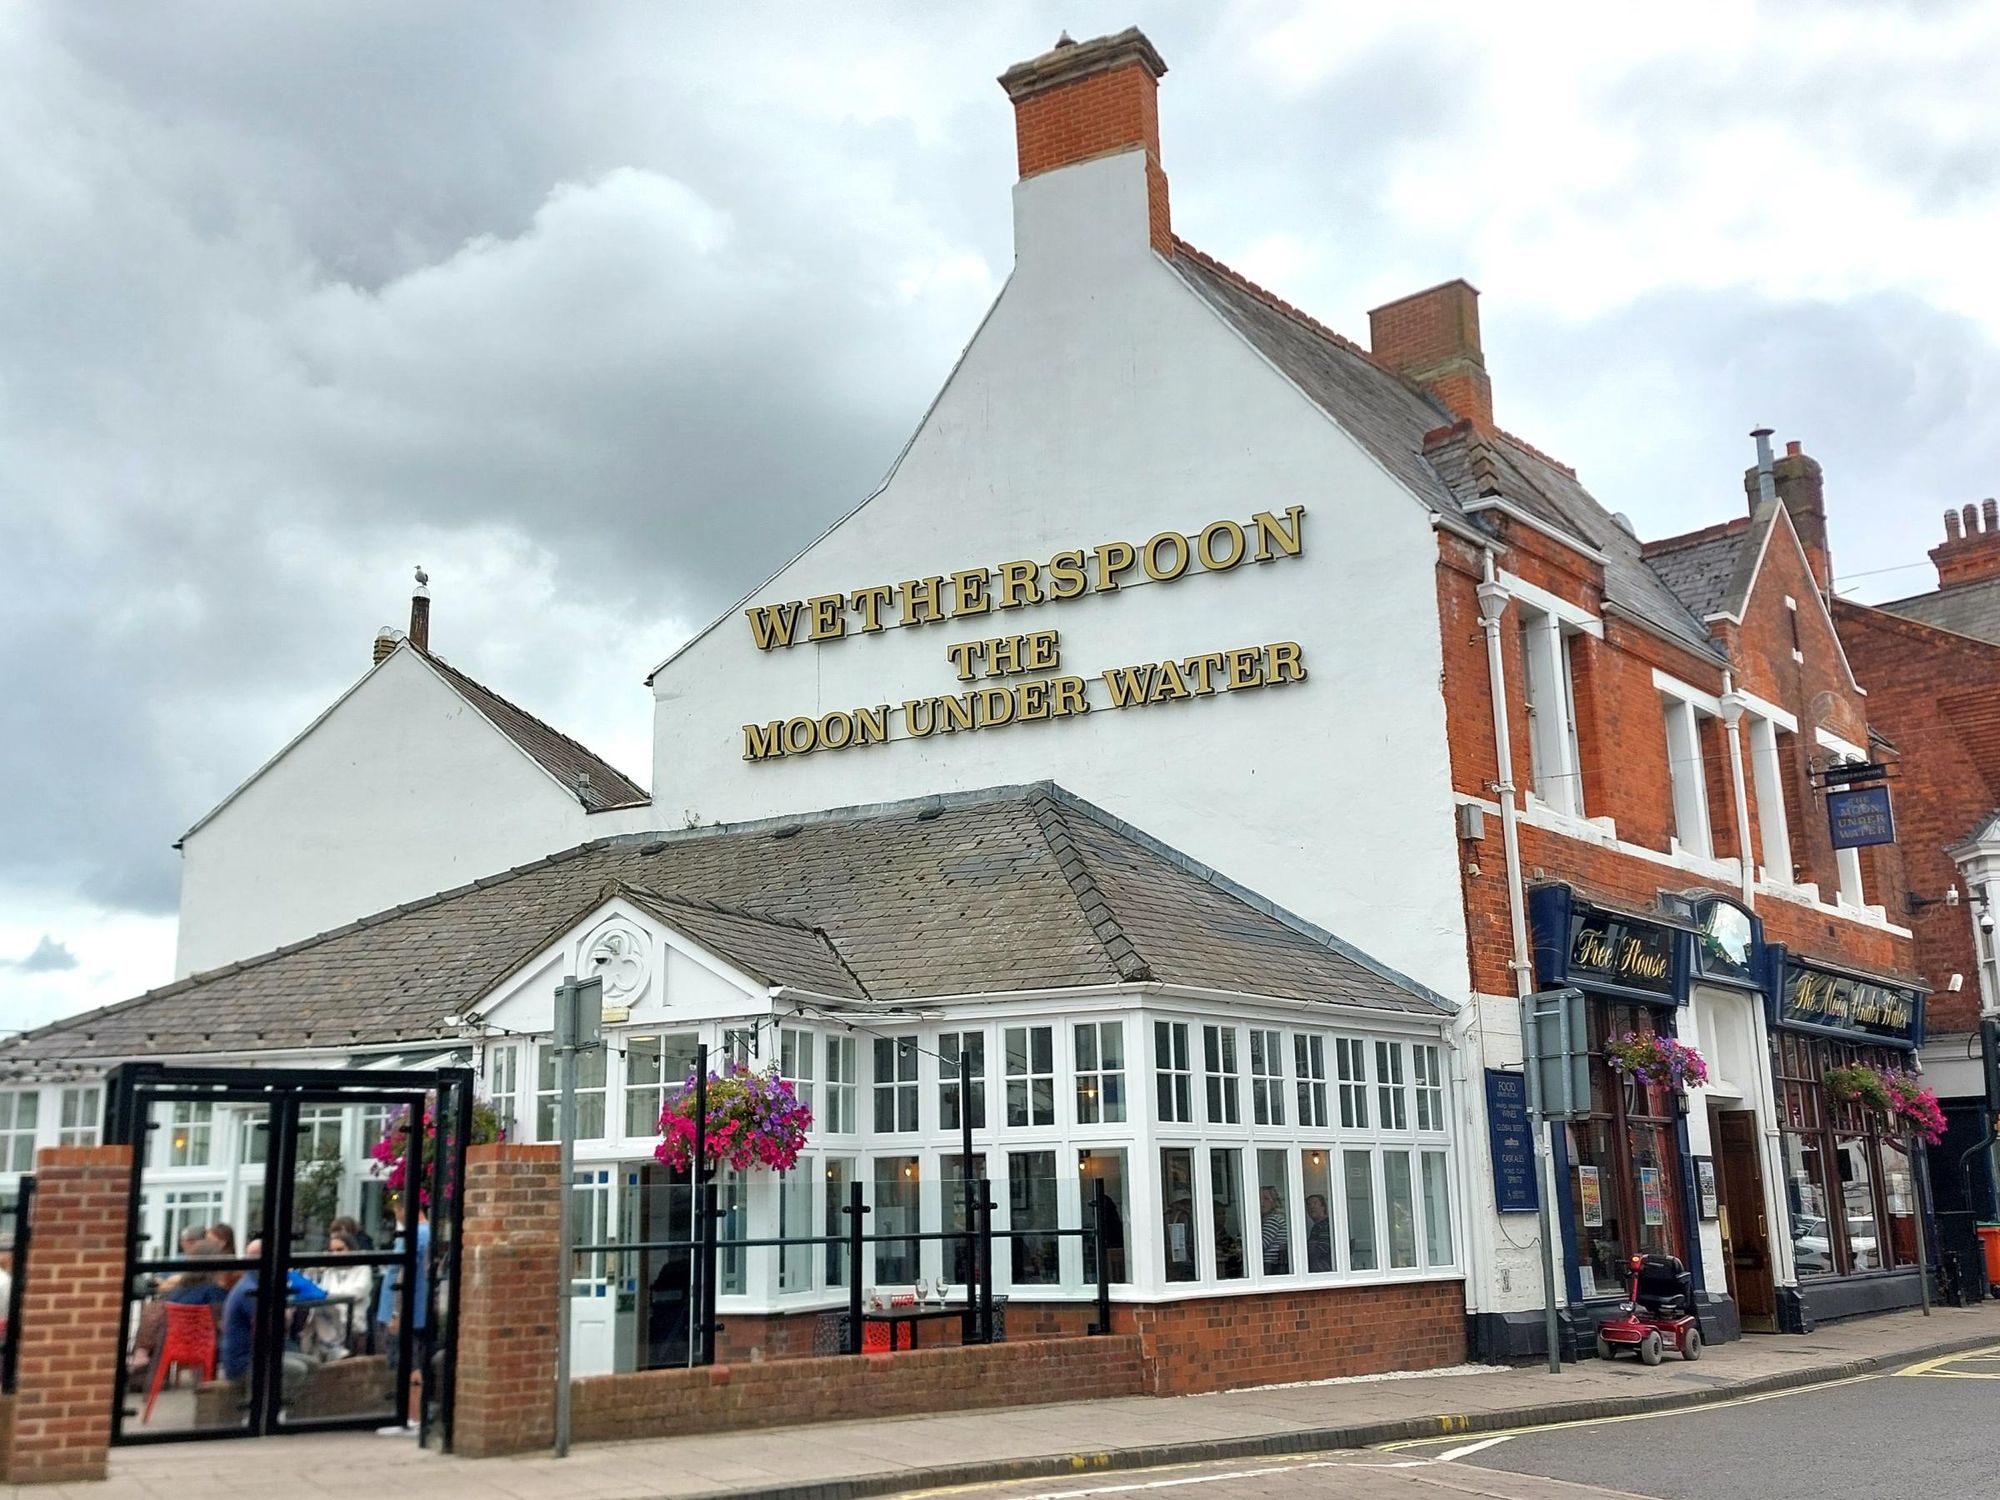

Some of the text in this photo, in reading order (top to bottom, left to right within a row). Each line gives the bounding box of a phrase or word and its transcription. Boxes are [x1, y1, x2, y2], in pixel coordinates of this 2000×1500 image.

[745, 504, 1306, 652] WETHERSPOON
[947, 628, 1061, 683] THE
[741, 640, 1309, 762] MOON UNDER WATER
[1838, 814, 1884, 827] UNDER
[1840, 803, 1881, 817] MOON
[1840, 825, 1886, 839] WATER
[1574, 928, 1668, 979] Free House
[1792, 974, 1816, 1012] The
[1814, 981, 1849, 1018] Moon
[1498, 1081, 1516, 1092] FOOD
